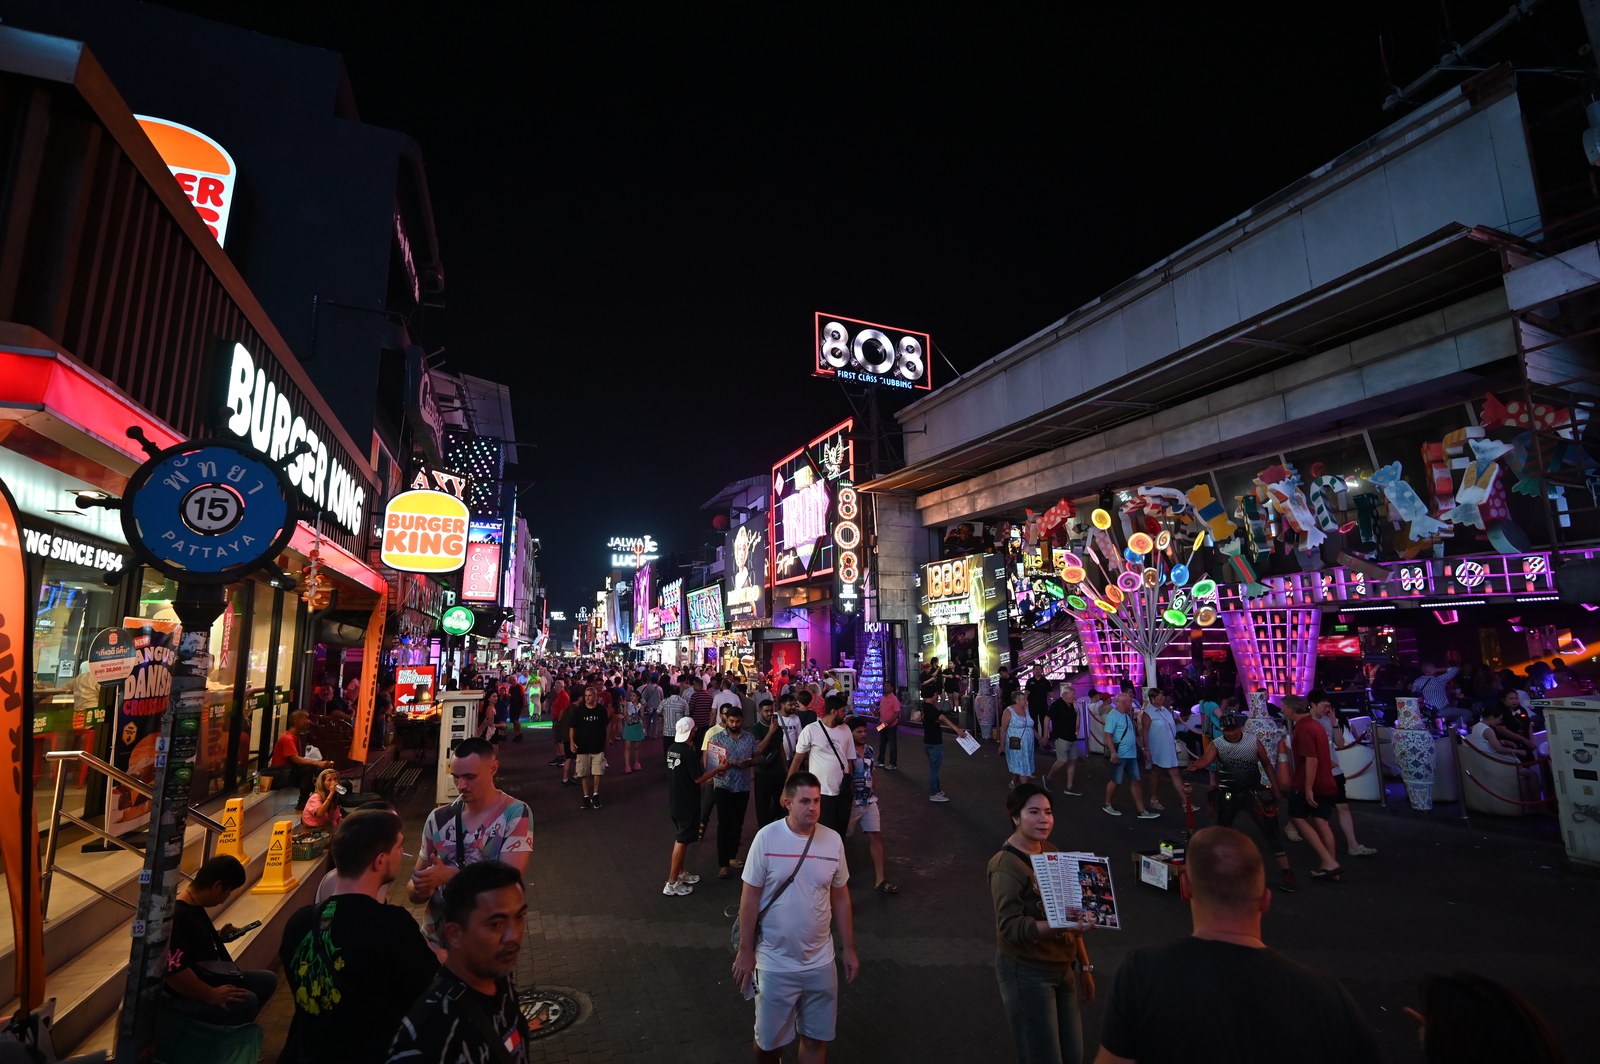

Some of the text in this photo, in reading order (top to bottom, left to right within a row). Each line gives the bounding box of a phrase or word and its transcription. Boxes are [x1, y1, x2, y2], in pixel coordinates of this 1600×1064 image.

[822, 321, 924, 380] 808
[837, 370, 856, 380] FIRST
[858, 373, 878, 383] CLASS
[227, 342, 363, 535] BURGER KING
[163, 457, 264, 495] พัทยา
[194, 497, 229, 522] 15
[387, 513, 466, 535] BURGER
[834, 488, 860, 584] 808
[23, 528, 123, 572] NG SINCE 1954
[161, 530, 255, 558] PATTAYA
[385, 530, 464, 556] KING
[607, 537, 644, 547] JALWA
[134, 636, 149, 647] NEW
[135, 646, 174, 665] ANGUS
[124, 665, 172, 700] DANISH
[396, 704, 431, 713] OPEN NOW
[158, 739, 165, 751] 3
[139, 872, 150, 882] 13
